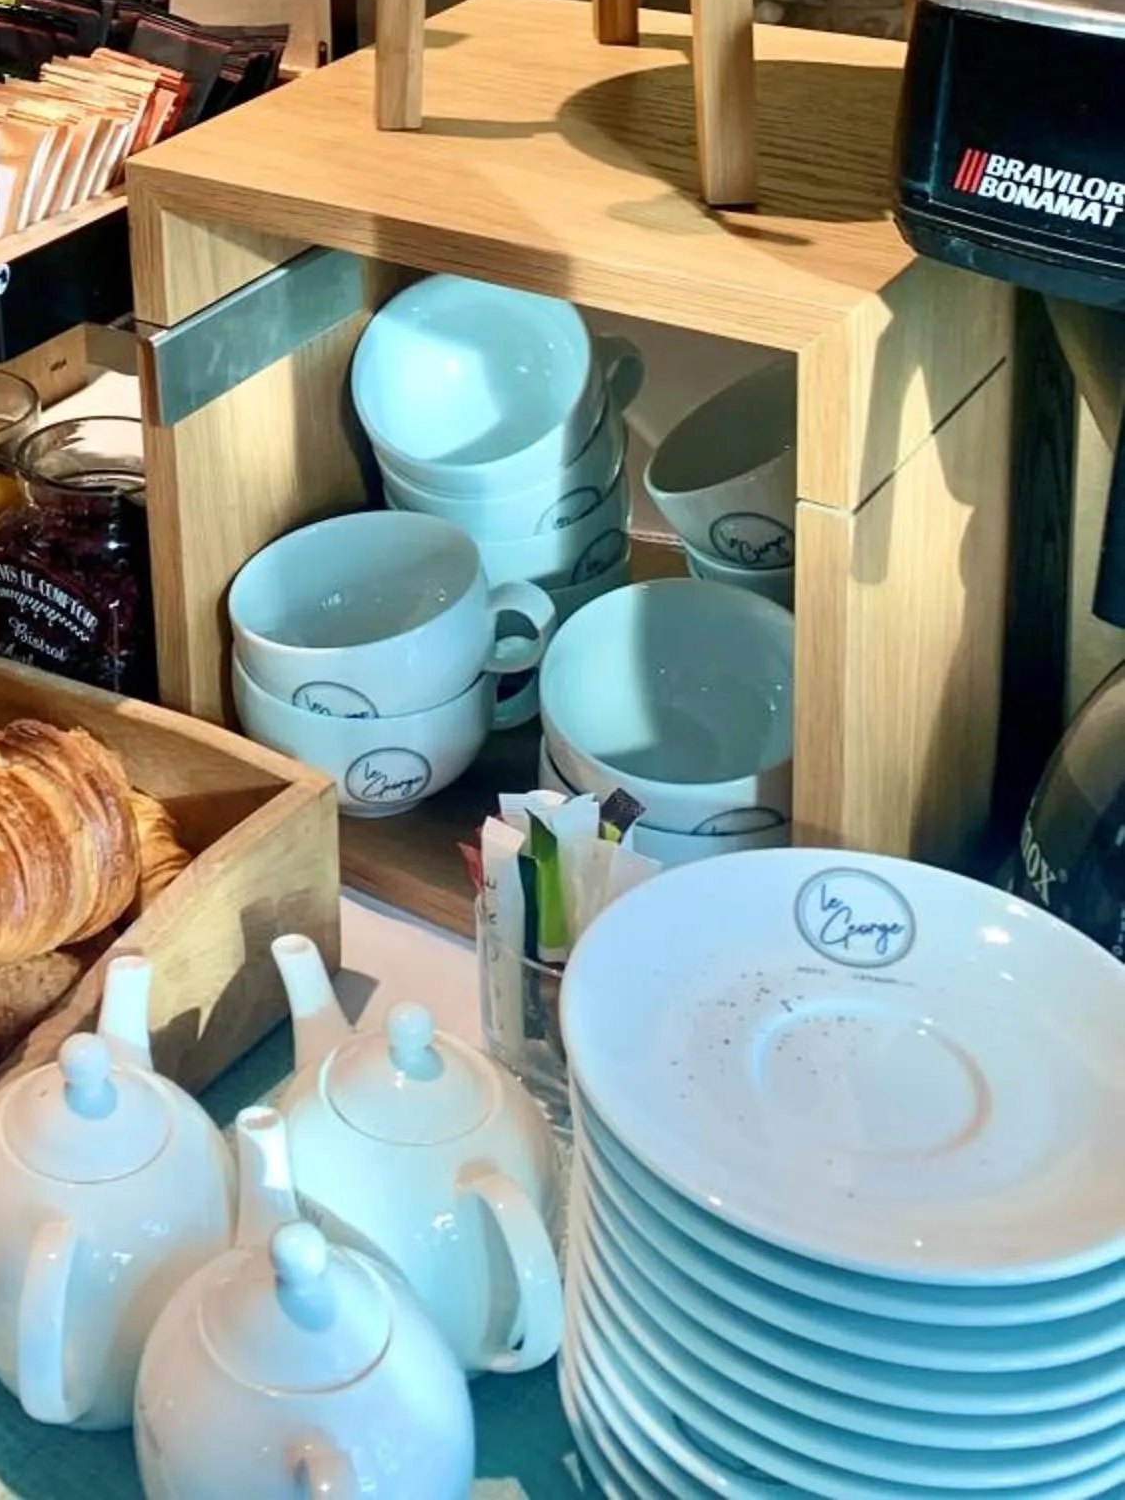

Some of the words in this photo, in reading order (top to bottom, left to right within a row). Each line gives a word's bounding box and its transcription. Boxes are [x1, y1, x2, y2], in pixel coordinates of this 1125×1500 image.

[977, 175, 1124, 228] BONAMAT
[985, 152, 1125, 207] BRAVILOR
[38, 579, 98, 634] COMPTOIR
[820, 883, 843, 912] Le
[819, 906, 904, 956] George
